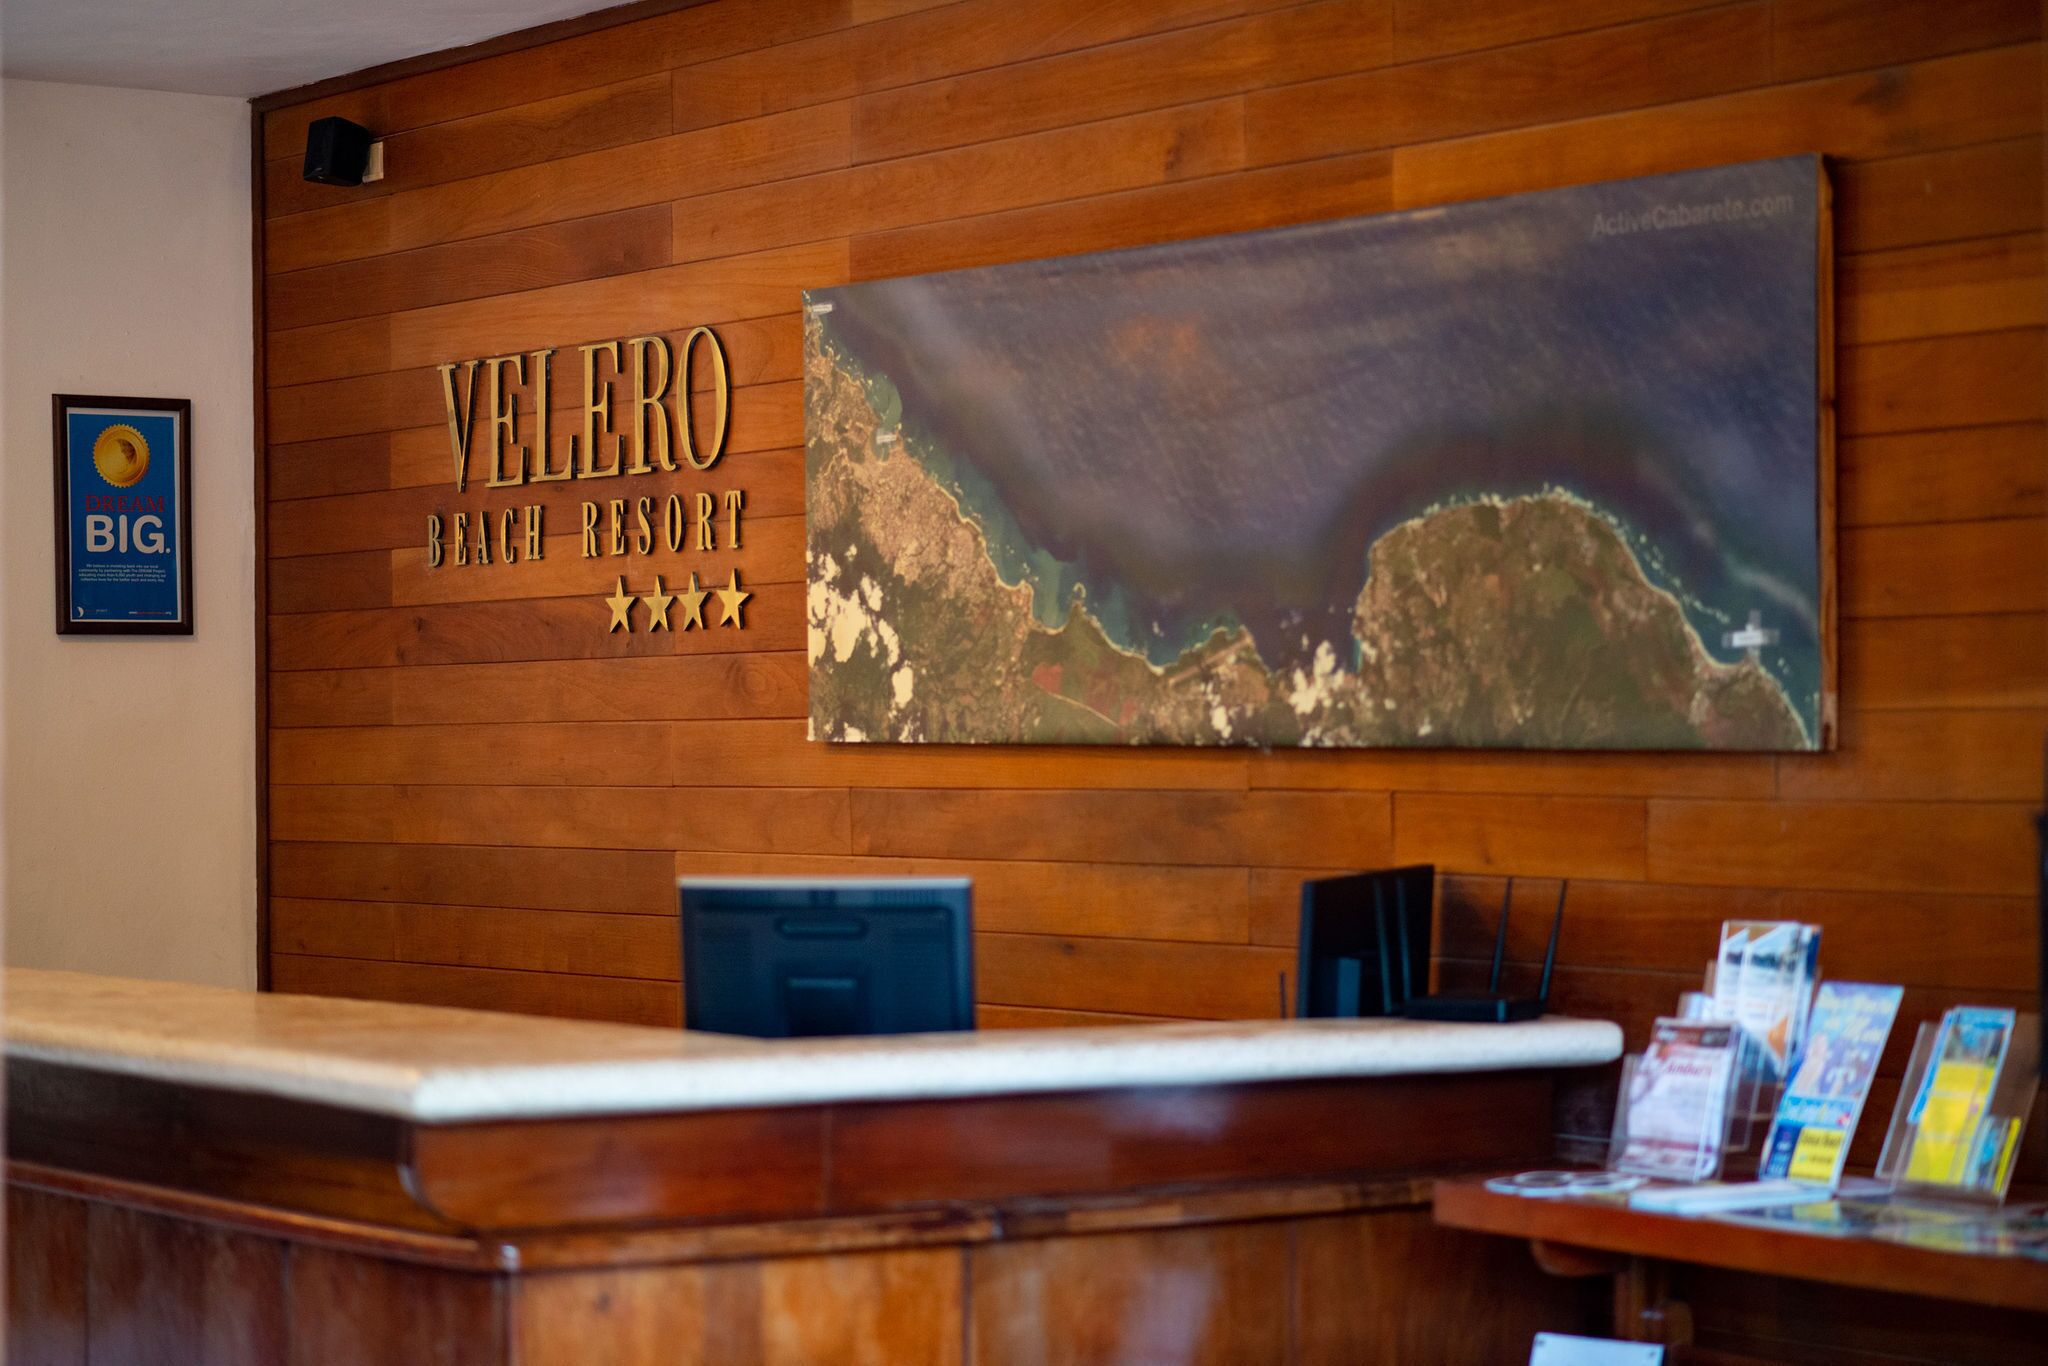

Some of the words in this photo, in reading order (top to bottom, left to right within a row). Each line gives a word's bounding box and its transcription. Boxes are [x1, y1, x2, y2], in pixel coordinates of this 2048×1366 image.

[437, 326, 731, 493] VELERO
[85, 495, 164, 512] DREAM
[427, 505, 545, 568] BEACH
[581, 489, 746, 558] RESORT
[86, 514, 170, 553] BIG.
